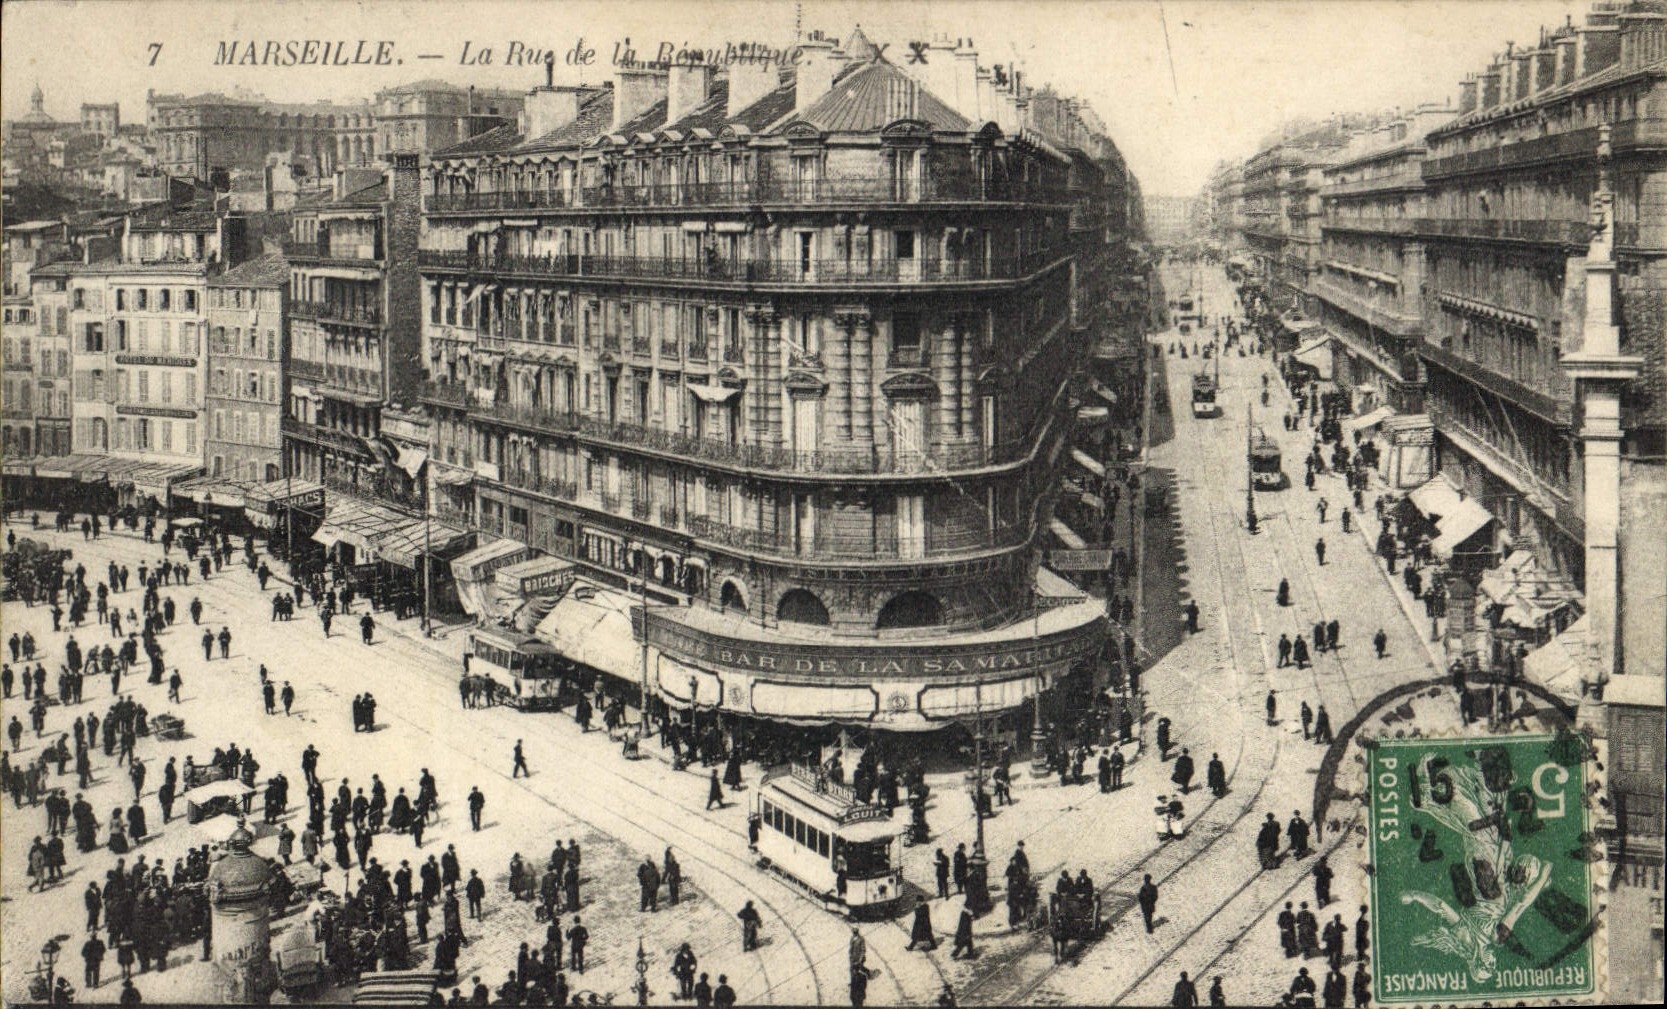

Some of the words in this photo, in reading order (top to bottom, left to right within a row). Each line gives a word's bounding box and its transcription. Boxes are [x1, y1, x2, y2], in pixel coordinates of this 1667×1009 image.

[721, 651, 776, 669] BAR
[796, 659, 836, 673] DE
[858, 661, 905, 673] LA
